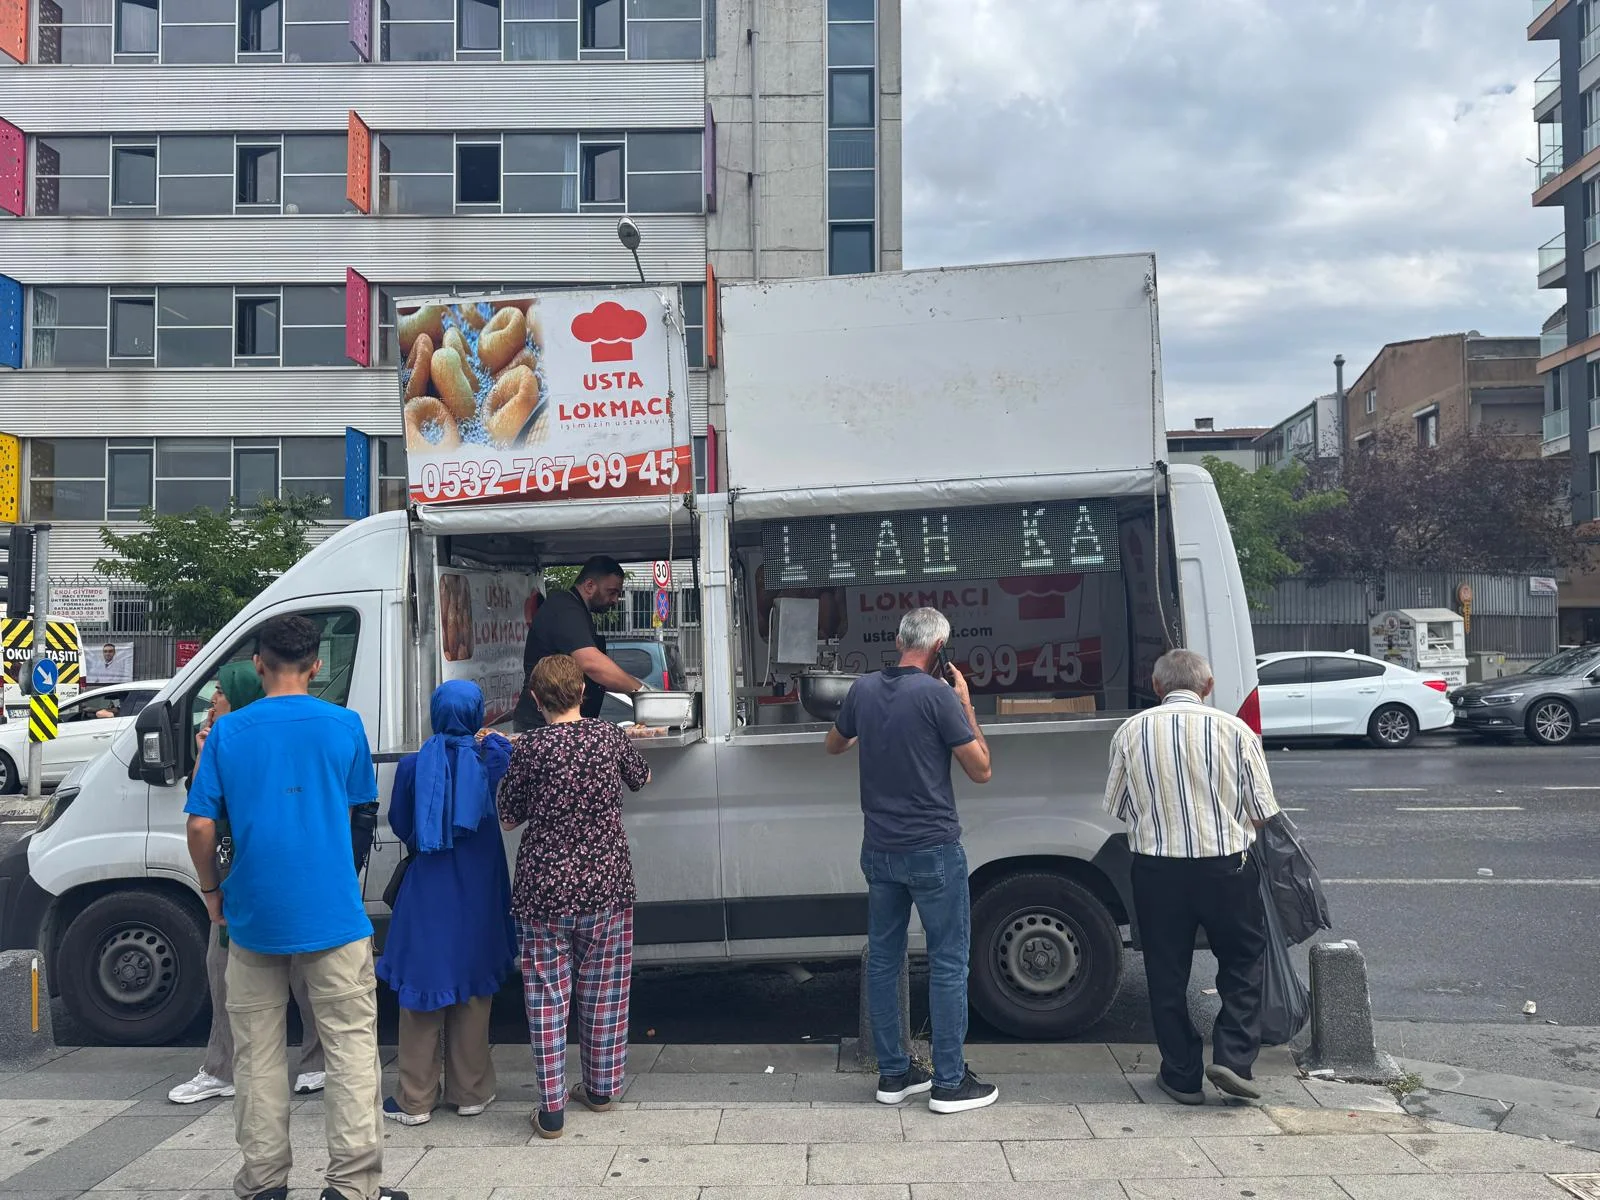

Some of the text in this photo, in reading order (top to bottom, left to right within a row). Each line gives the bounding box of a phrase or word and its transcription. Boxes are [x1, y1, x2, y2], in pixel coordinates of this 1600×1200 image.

[583, 371, 644, 390] USTA
[559, 397, 672, 421] LOKMACI
[421, 450, 680, 499] 0532 767 99 45
[781, 505, 1105, 581] LLAH KA
[656, 564, 667, 578] 30
[859, 587, 989, 613] LOKMACI
[45, 650, 77, 663] TAŞITI
[968, 644, 1018, 687] 99
[1032, 642, 1082, 684] 45
